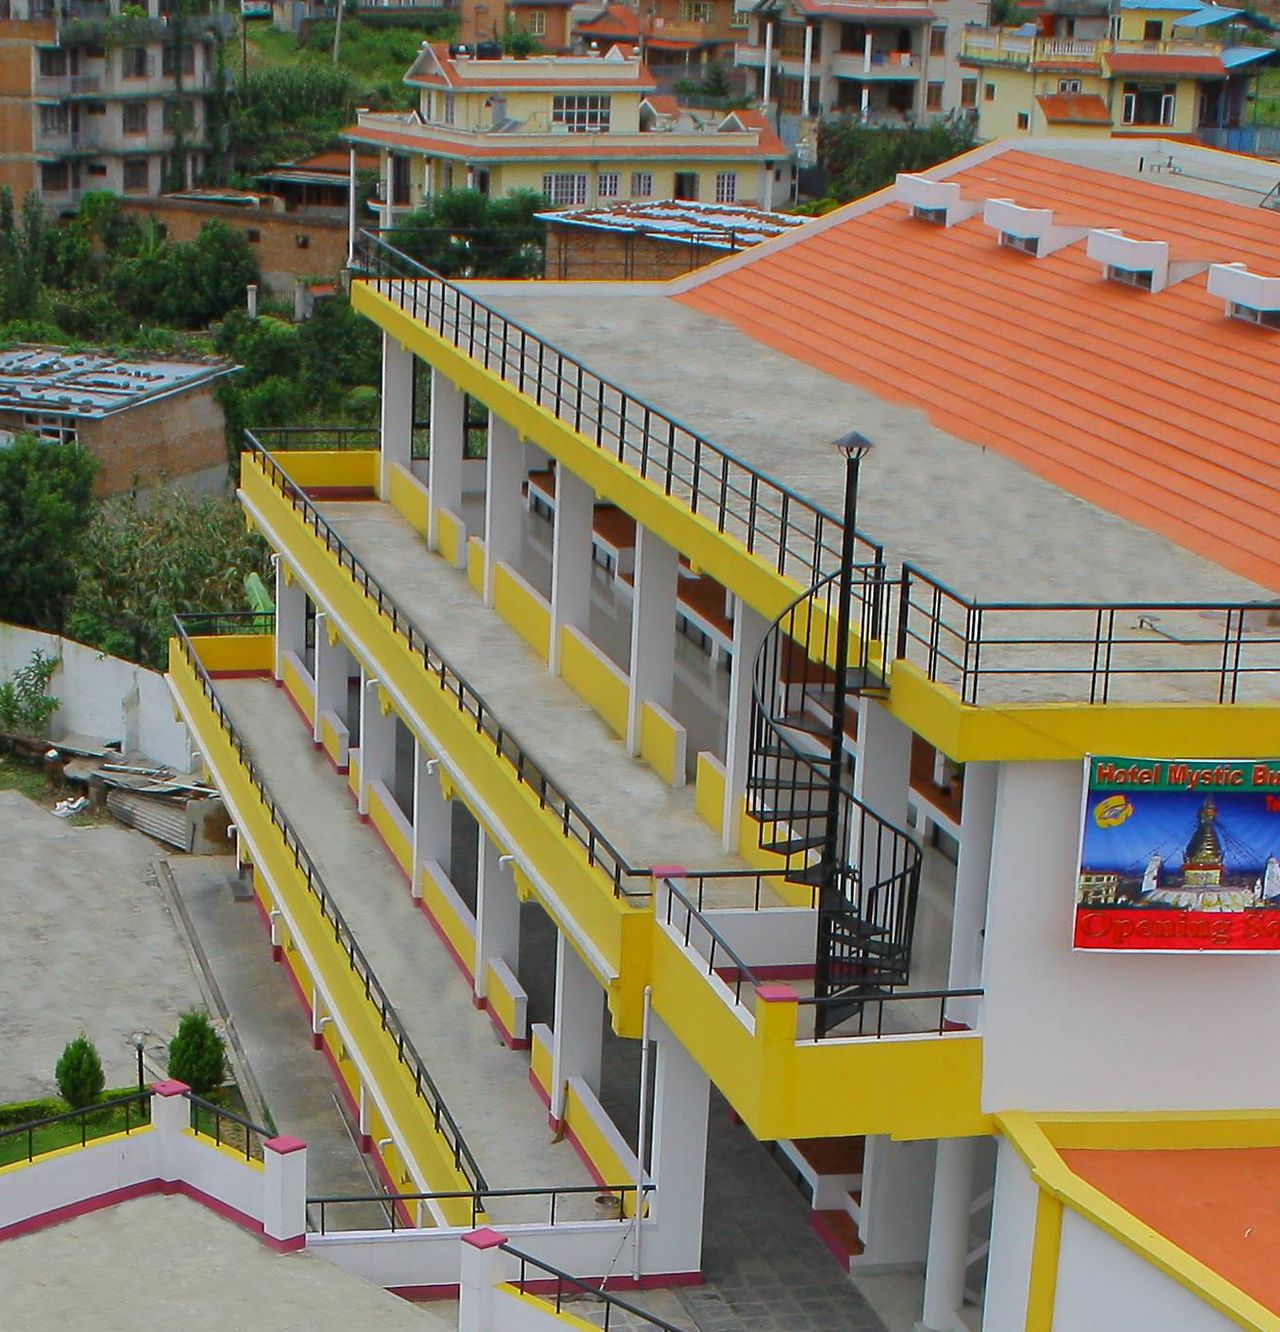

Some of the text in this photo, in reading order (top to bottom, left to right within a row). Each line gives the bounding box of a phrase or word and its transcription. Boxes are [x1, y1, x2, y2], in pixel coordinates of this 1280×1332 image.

[1097, 762, 1160, 784] Hotel
[1167, 763, 1243, 789] Mystic
[1080, 912, 1232, 944] Opening
